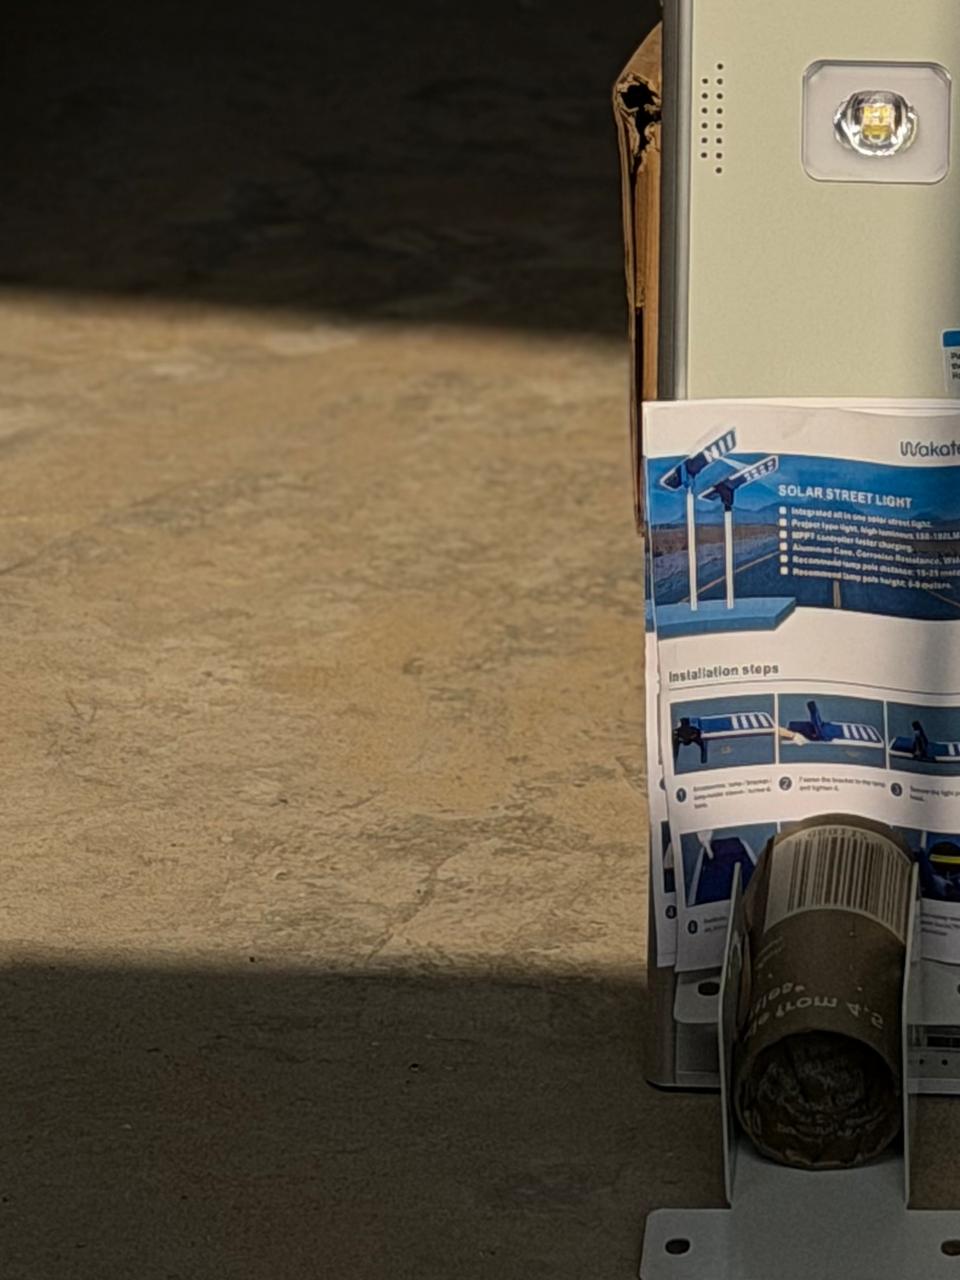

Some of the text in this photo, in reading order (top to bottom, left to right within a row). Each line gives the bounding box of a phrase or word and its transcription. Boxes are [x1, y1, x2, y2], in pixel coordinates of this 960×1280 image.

[778, 484, 913, 509] SOLAR STREET LIGHT
[791, 507, 832, 517] Integrated
[792, 568, 842, 579] Recommend
[668, 664, 779, 683] Installation steps
